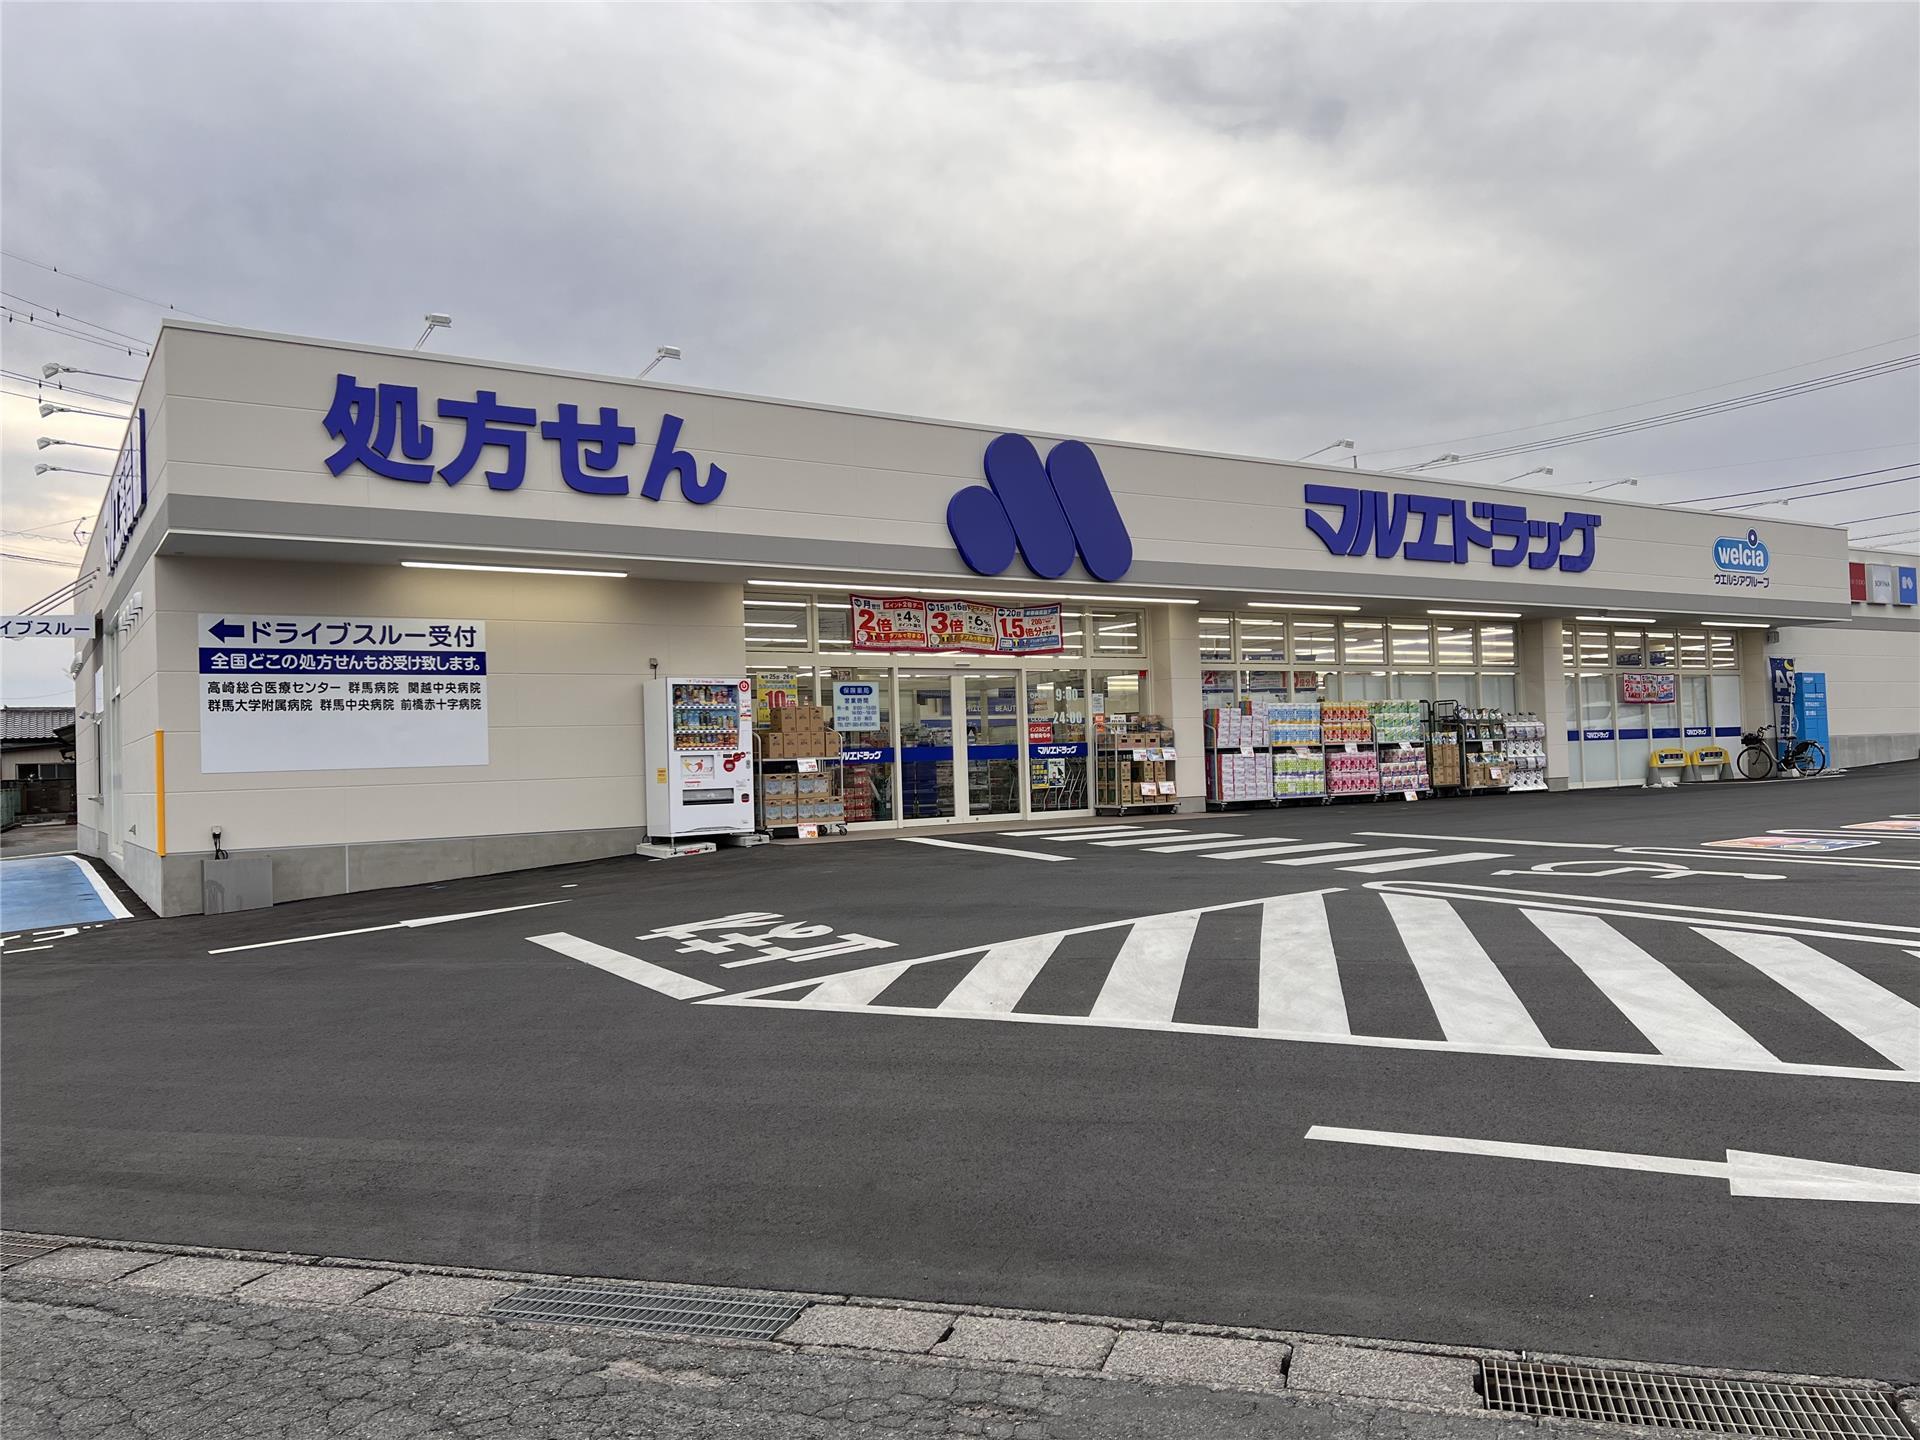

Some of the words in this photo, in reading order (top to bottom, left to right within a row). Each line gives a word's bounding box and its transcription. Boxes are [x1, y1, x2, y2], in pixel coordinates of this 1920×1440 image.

[322, 373, 728, 505] 処方せん
[1303, 483, 1601, 573] マルエドラッグ
[1718, 543, 1765, 567] welcia
[1713, 574, 1770, 588] ウエルシアグループ
[858, 609, 892, 632] 2倍
[931, 612, 964, 633] 3倍
[250, 621, 477, 648] ドライブスルー受付
[211, 652, 480, 671] 全国どこの処方せんもお受け致します。
[207, 681, 341, 694] 高崎総合医療センター
[348, 681, 399, 694] 群馬病院
[407, 681, 481, 694] 関越中央病院
[1056, 688, 1078, 701] 9:00
[207, 699, 313, 712] 群馬大学附属病院
[320, 699, 394, 711] 群馬中央病院
[400, 698, 482, 711] 前橋赤十字病院
[1053, 711, 1083, 724] 24:00
[1038, 746, 1077, 754] マルエドラッグ
